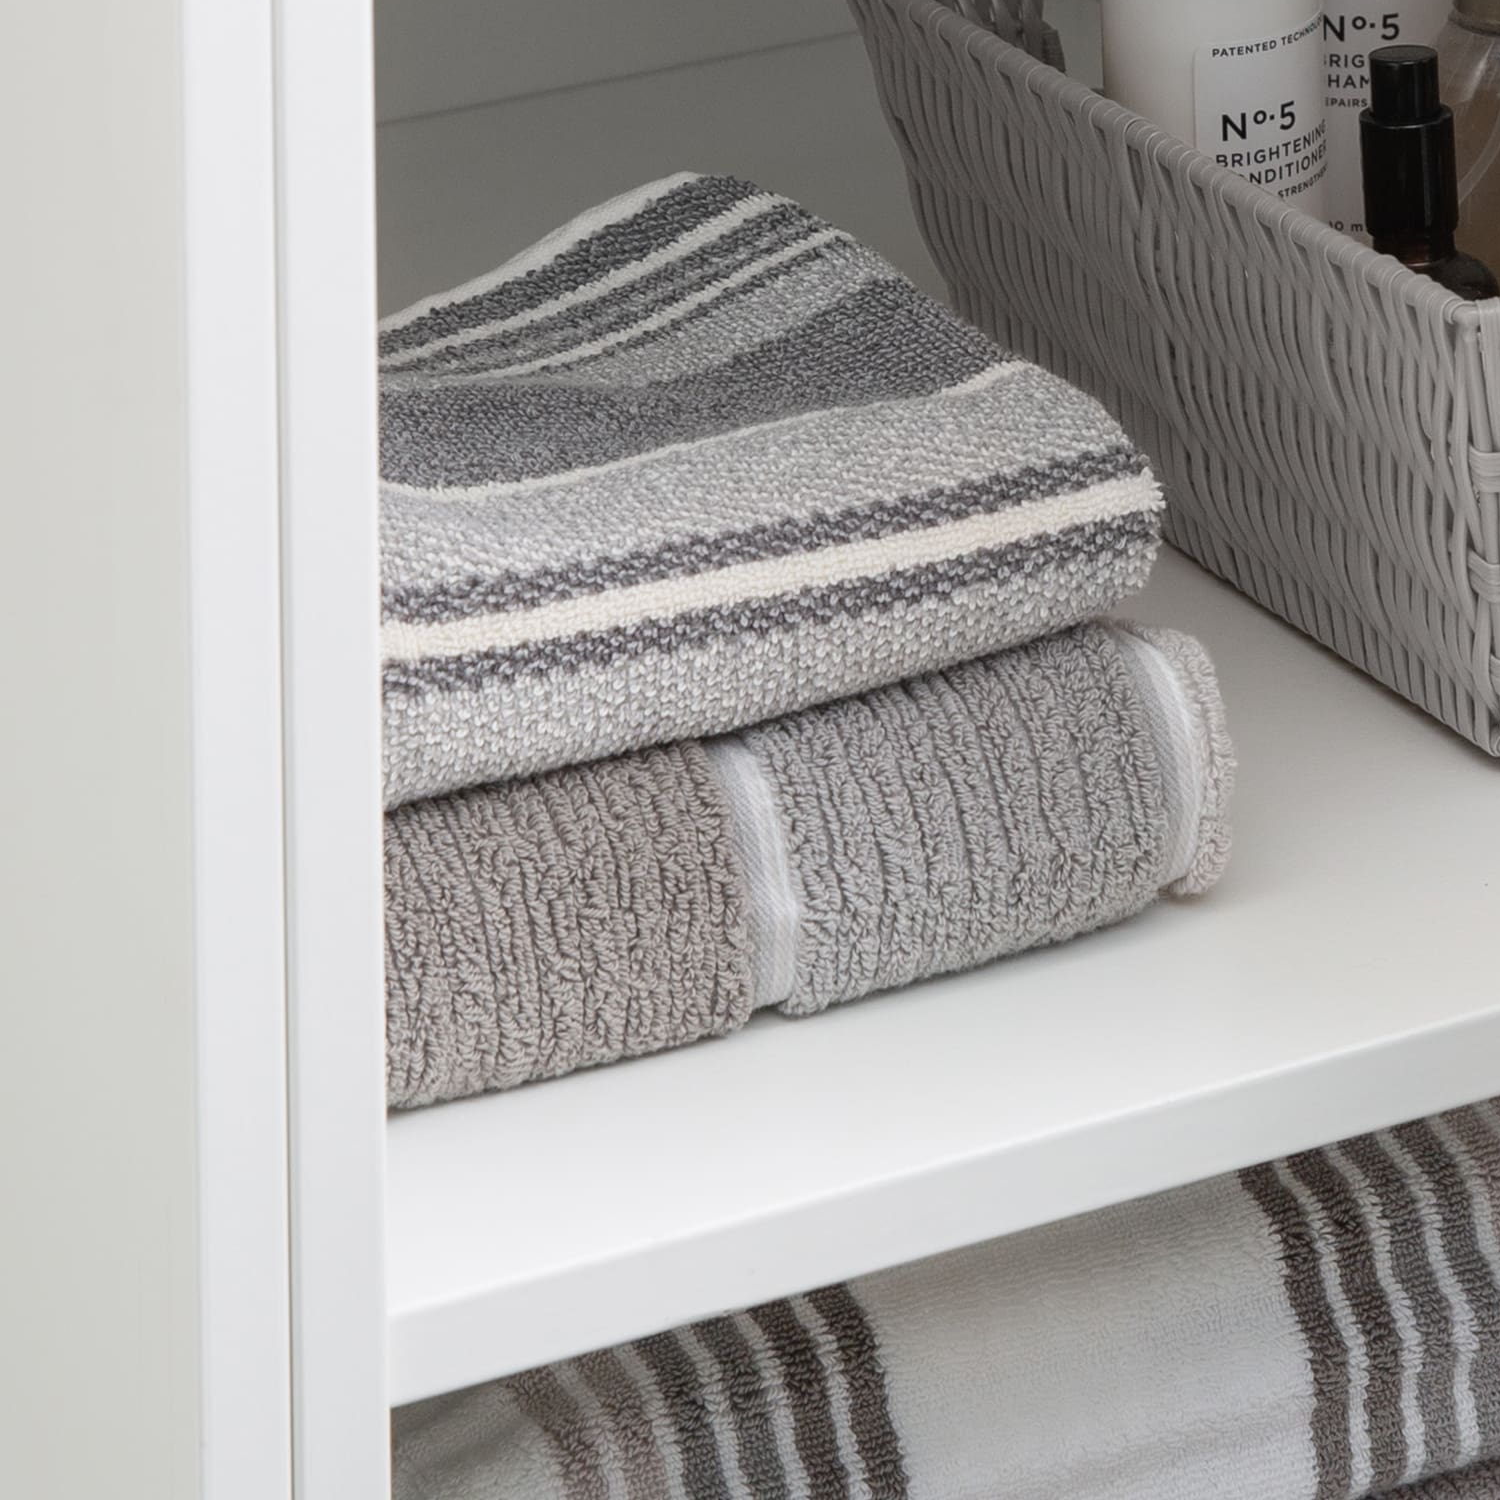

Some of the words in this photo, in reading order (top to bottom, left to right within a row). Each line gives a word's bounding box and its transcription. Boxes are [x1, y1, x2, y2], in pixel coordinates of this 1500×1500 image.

[1212, 40, 1277, 57] PATENTED
[1323, 54, 1365, 68] RIG
[1325, 97, 1367, 108] PAIRS
